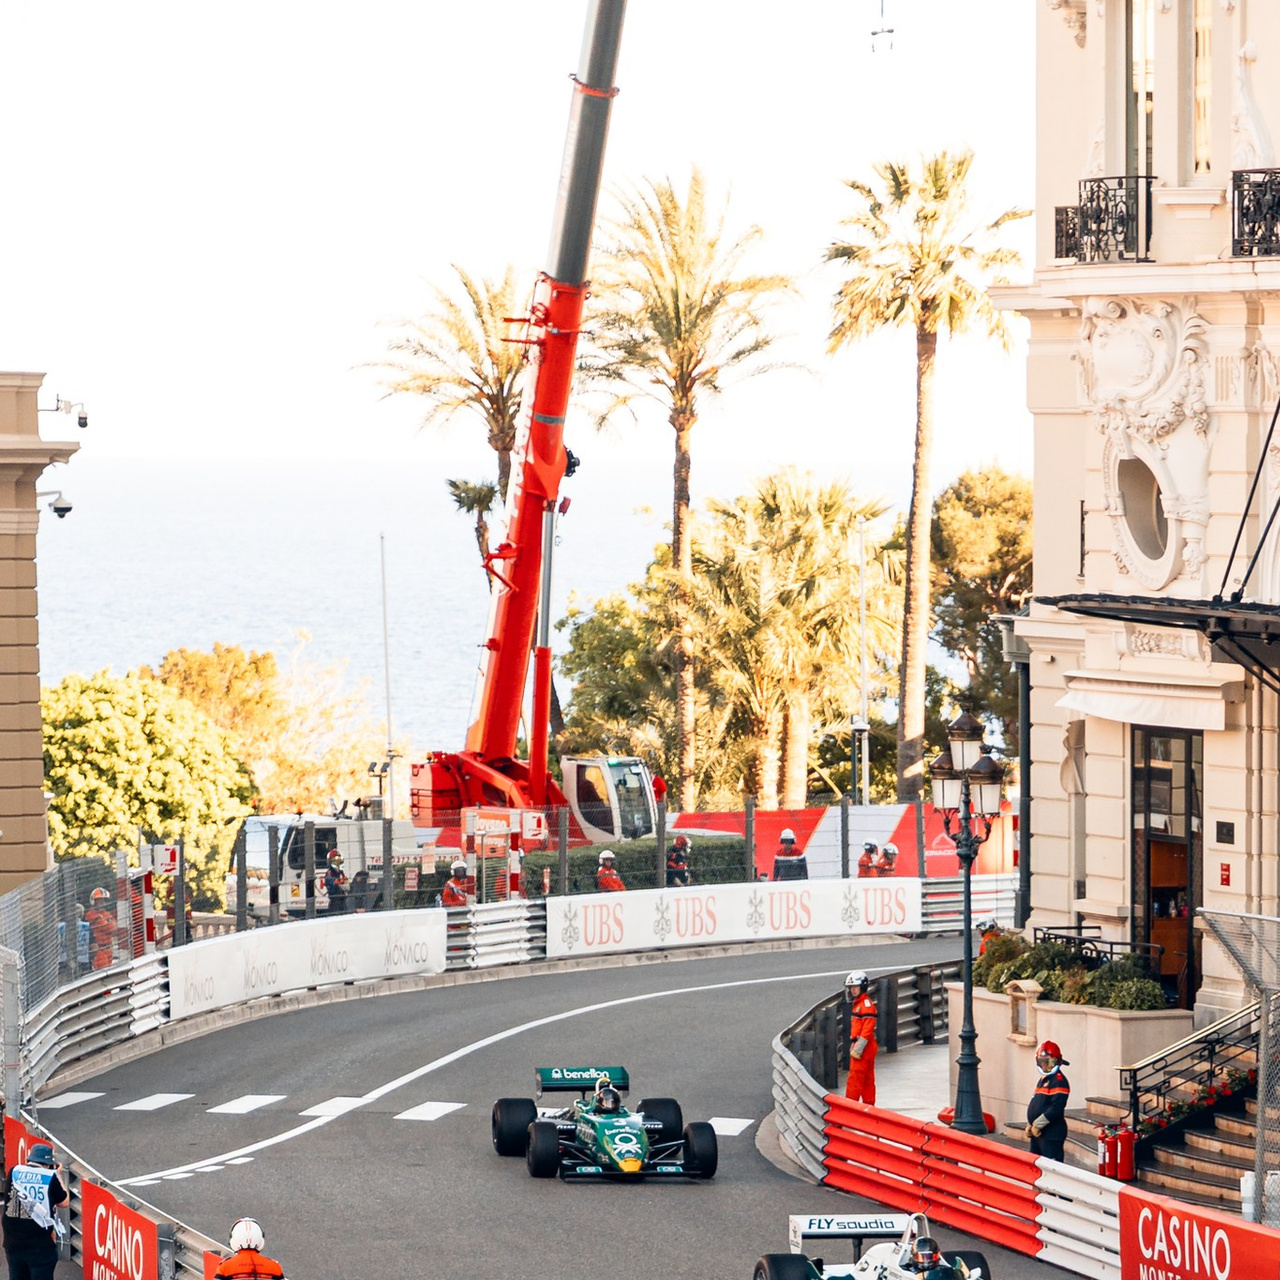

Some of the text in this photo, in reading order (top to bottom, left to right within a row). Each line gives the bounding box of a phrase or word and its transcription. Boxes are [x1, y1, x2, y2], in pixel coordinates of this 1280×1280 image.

[583, 903, 624, 947] UBS
[676, 896, 716, 938] UBS
[769, 890, 811, 930] UBS
[863, 888, 906, 926] UBS
[808, 1218, 895, 1230] FLY saudia
